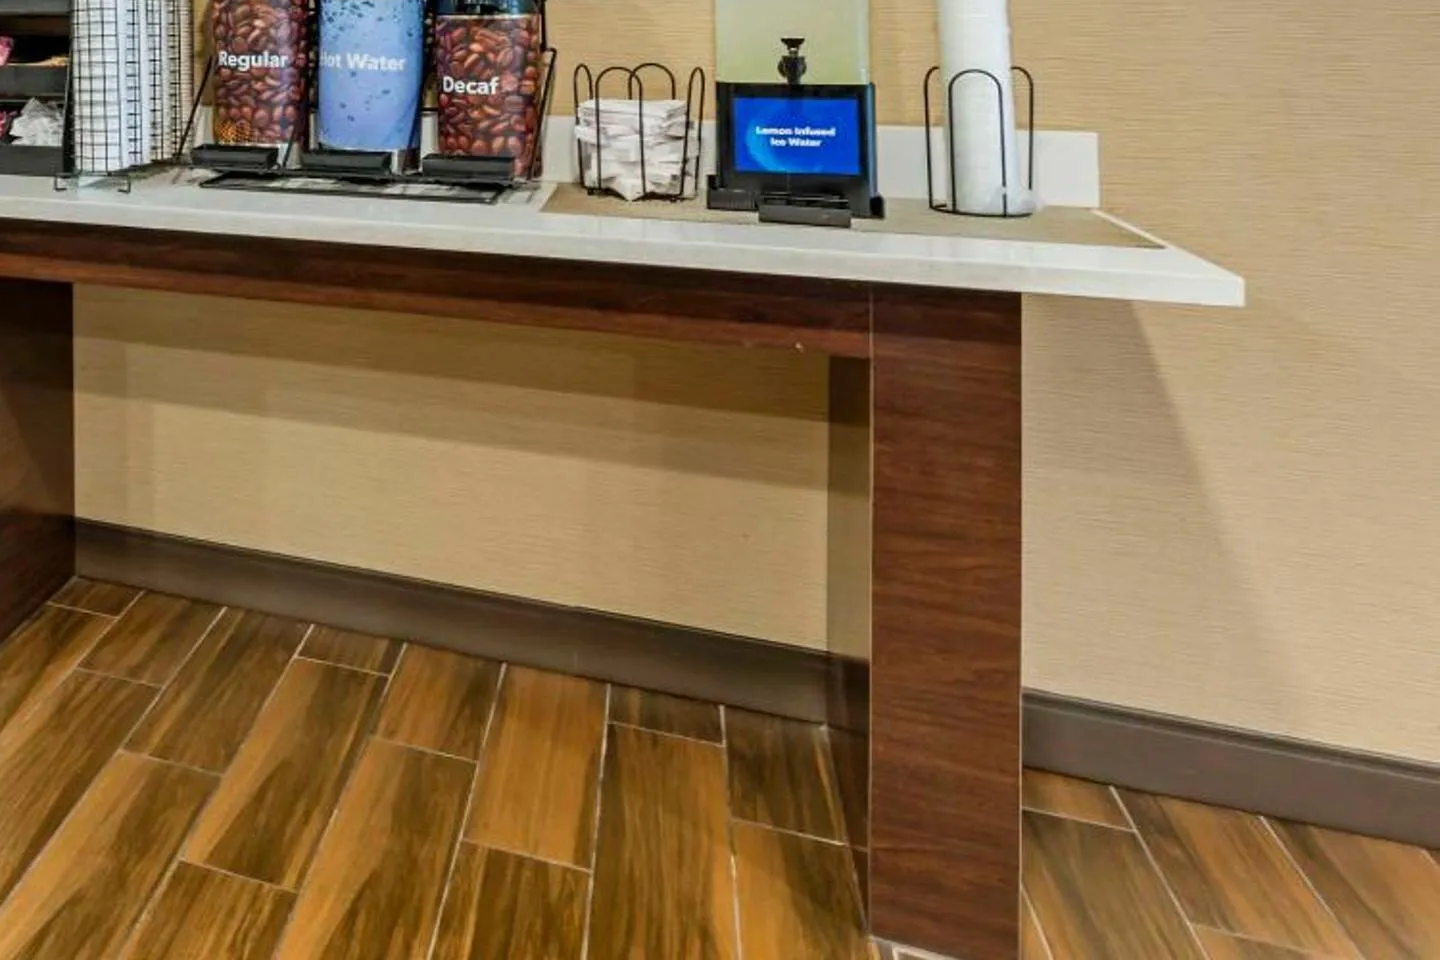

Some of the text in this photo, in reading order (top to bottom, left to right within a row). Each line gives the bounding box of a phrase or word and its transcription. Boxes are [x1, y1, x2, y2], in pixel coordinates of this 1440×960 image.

[218, 50, 289, 72] Regular
[346, 52, 407, 72] Water
[443, 75, 500, 96] Decaf
[755, 125, 837, 137] Lemon Infused
[769, 137, 823, 148] Ice Water
